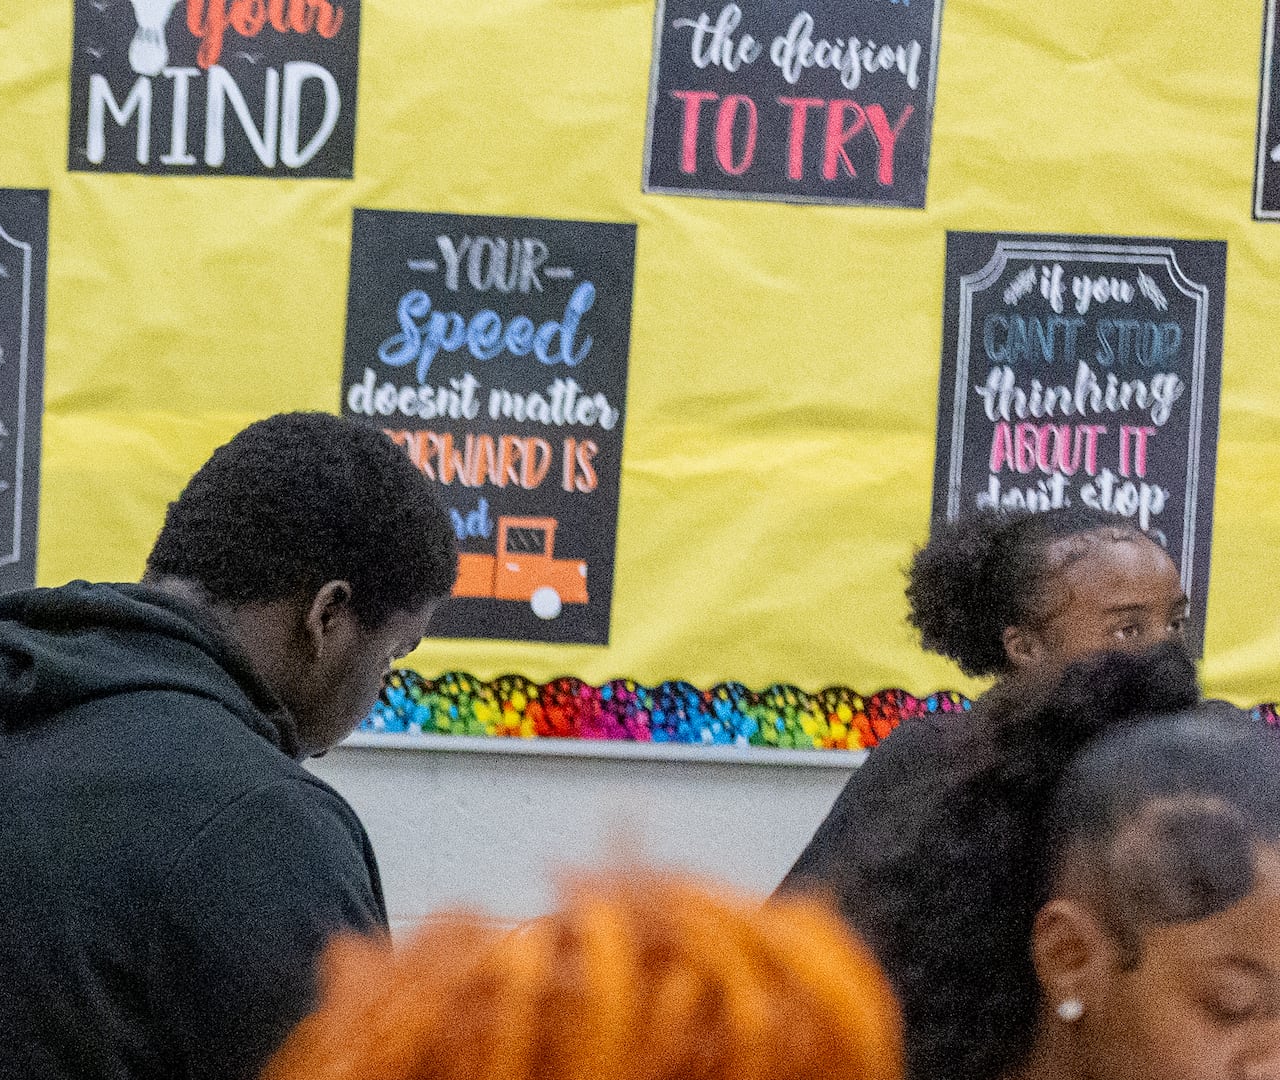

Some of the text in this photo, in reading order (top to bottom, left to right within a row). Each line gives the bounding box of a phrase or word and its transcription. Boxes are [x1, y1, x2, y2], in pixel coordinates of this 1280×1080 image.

[186, 0, 344, 69] your
[673, 3, 921, 91] the decision
[86, 60, 341, 169] MIND
[672, 89, 915, 185] TO TRY
[1040, 263, 1135, 315] if you
[378, 280, 596, 386] Speed
[1095, 317, 1183, 368] STOP
[489, 376, 620, 431] matter
[975, 359, 1185, 427] thinking
[562, 436, 598, 493] IS
[990, 421, 1157, 479] ABOUT IT
[1080, 467, 1170, 531] stop
